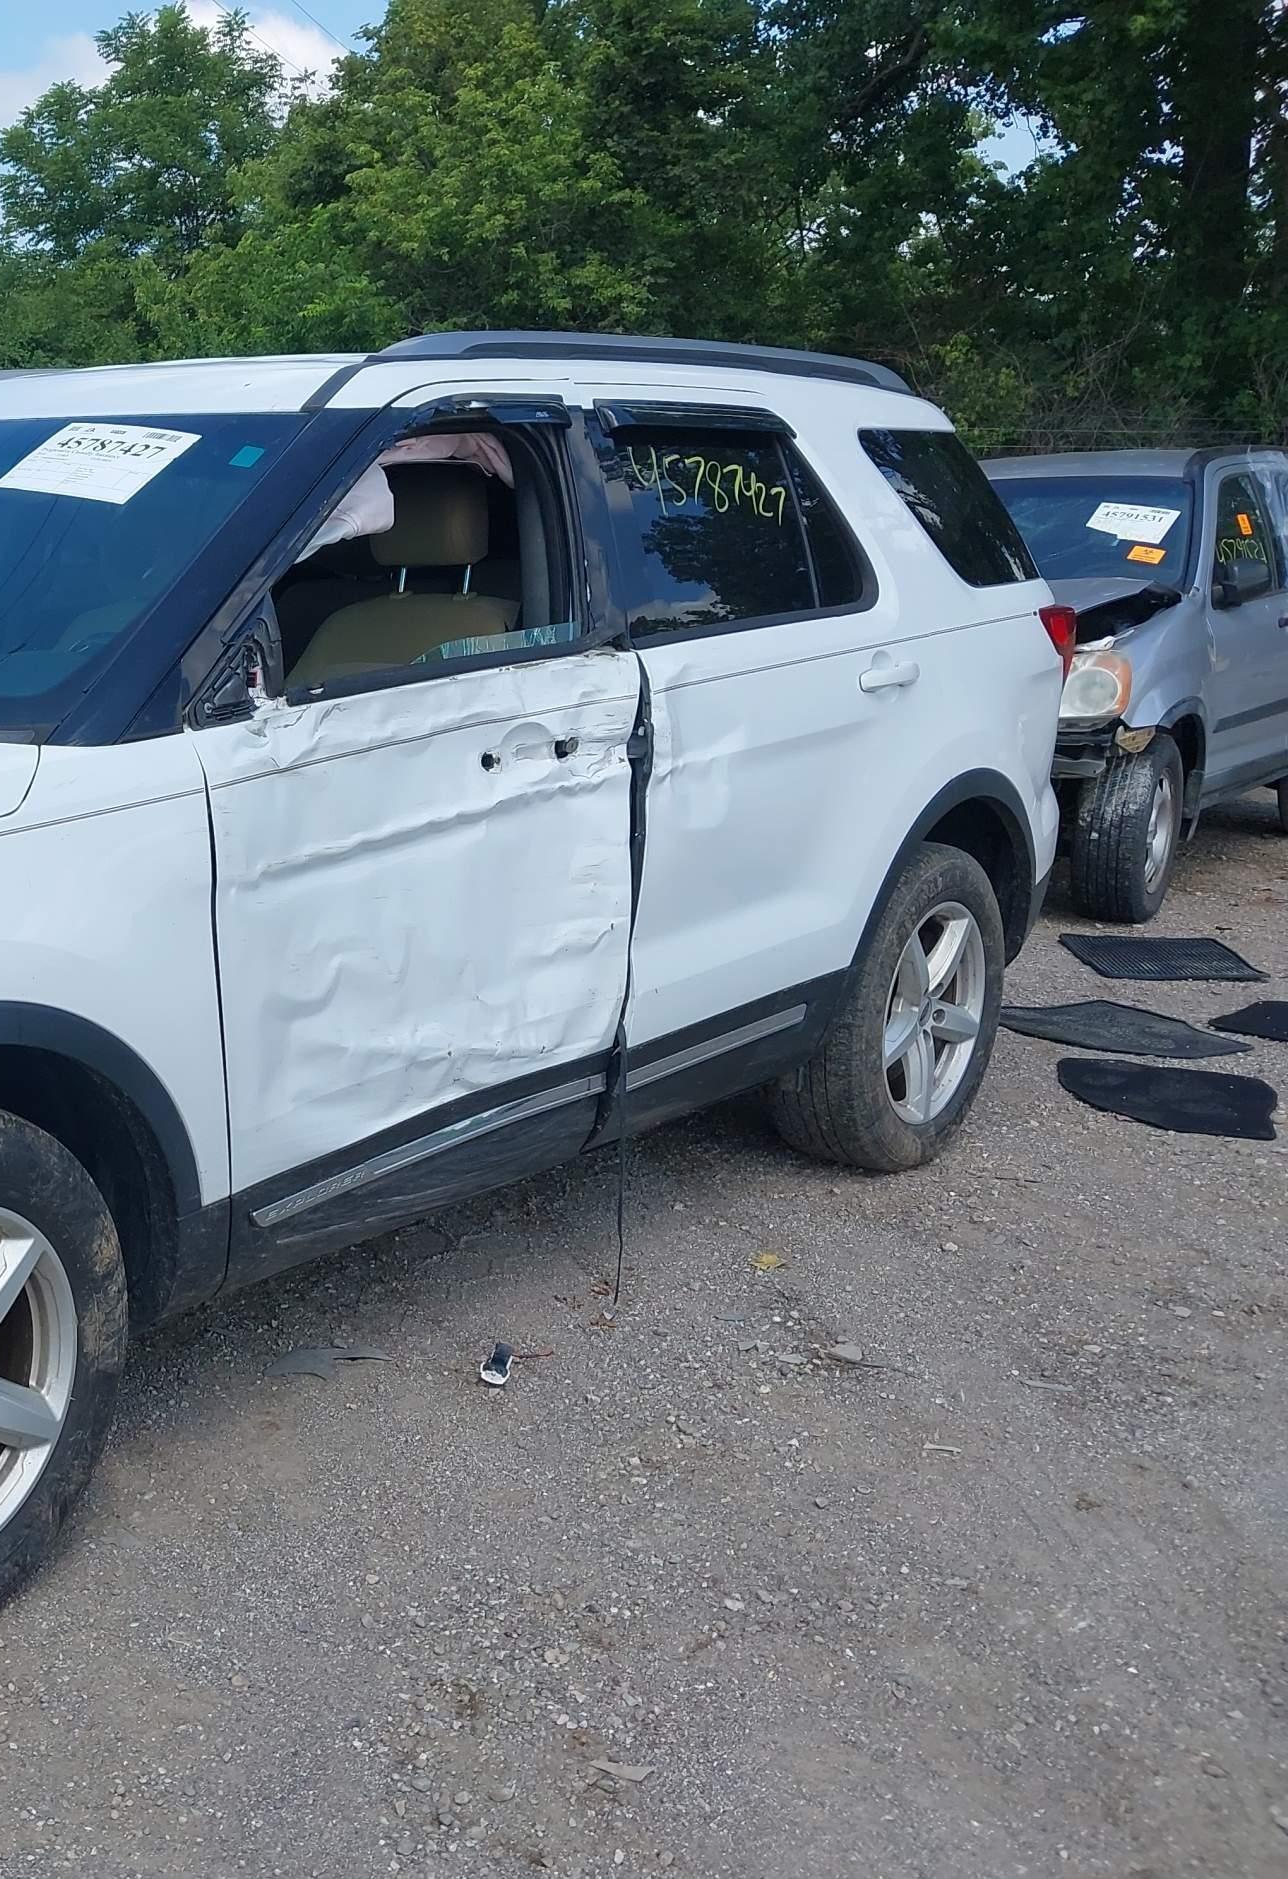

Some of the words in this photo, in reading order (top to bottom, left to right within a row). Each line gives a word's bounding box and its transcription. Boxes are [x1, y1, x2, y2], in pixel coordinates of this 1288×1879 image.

[57, 436, 168, 459] 45787427
[626, 446, 787, 528] 45787427
[1102, 510, 1165, 523] 45791531
[264, 1170, 366, 1221] EXPLORER
